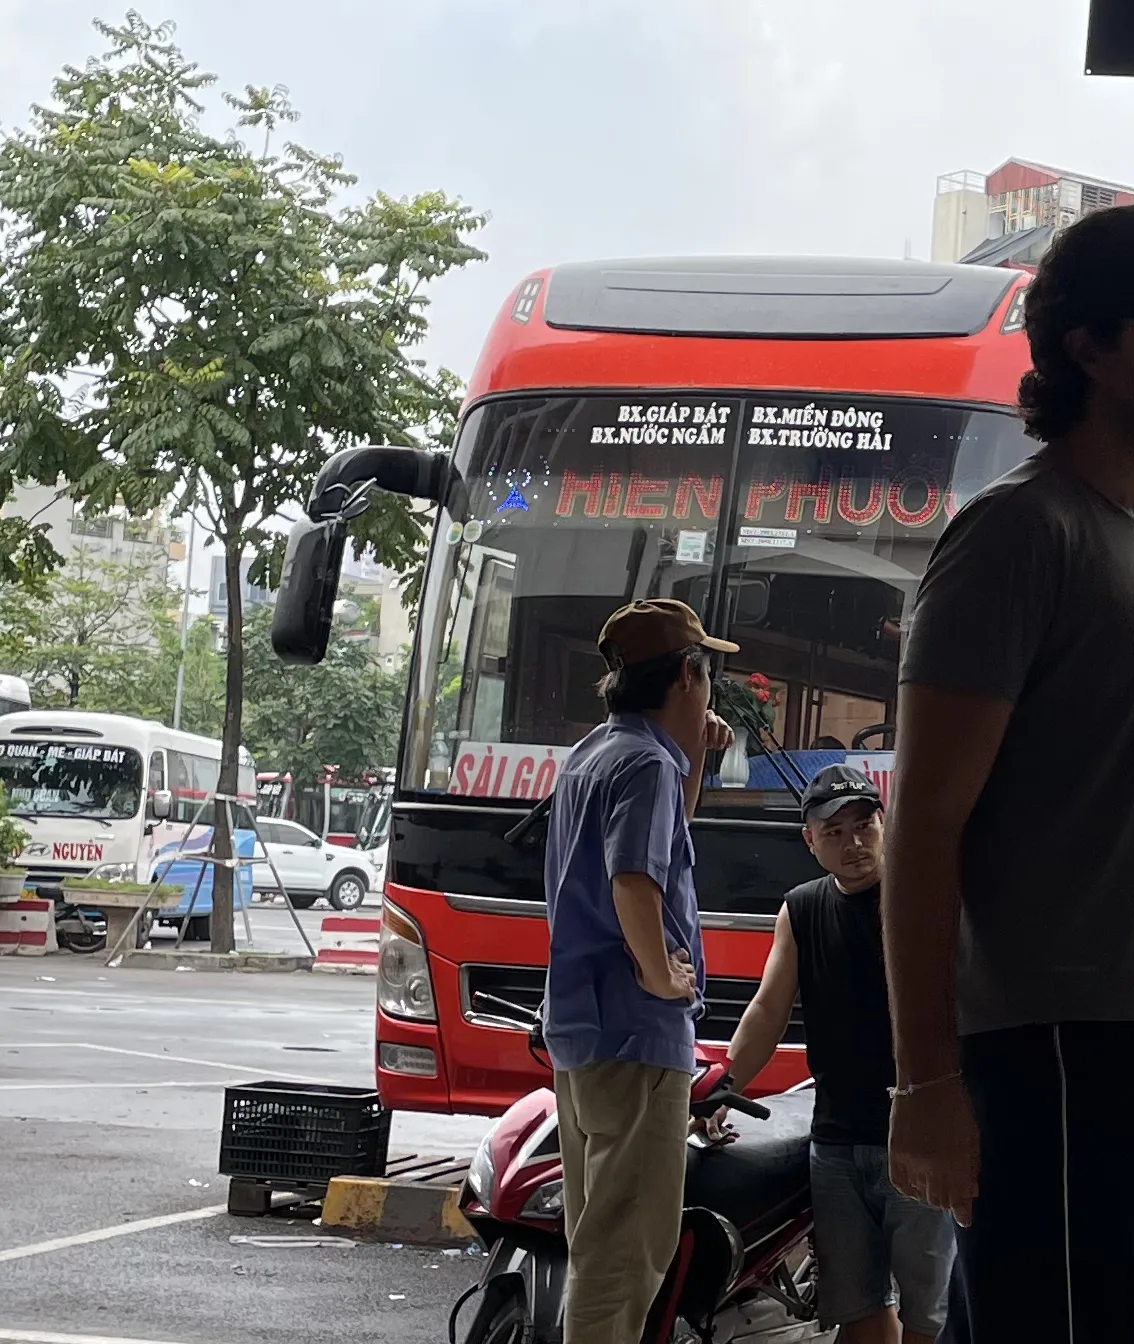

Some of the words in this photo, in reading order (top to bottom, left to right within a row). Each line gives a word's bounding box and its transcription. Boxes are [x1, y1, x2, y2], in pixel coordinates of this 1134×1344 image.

[617, 402, 691, 422] BX.GIÁP
[693, 402, 731, 423] BÁT
[830, 407, 884, 428] ĐÔNG
[590, 424, 669, 444] BX.NƯỚC
[747, 427, 854, 448] BX.TRƯỜNG
[856, 428, 893, 450] HẢI
[7, 744, 38, 758] QUAN
[450, 745, 508, 796] SÀI
[511, 748, 566, 799] GÒ
